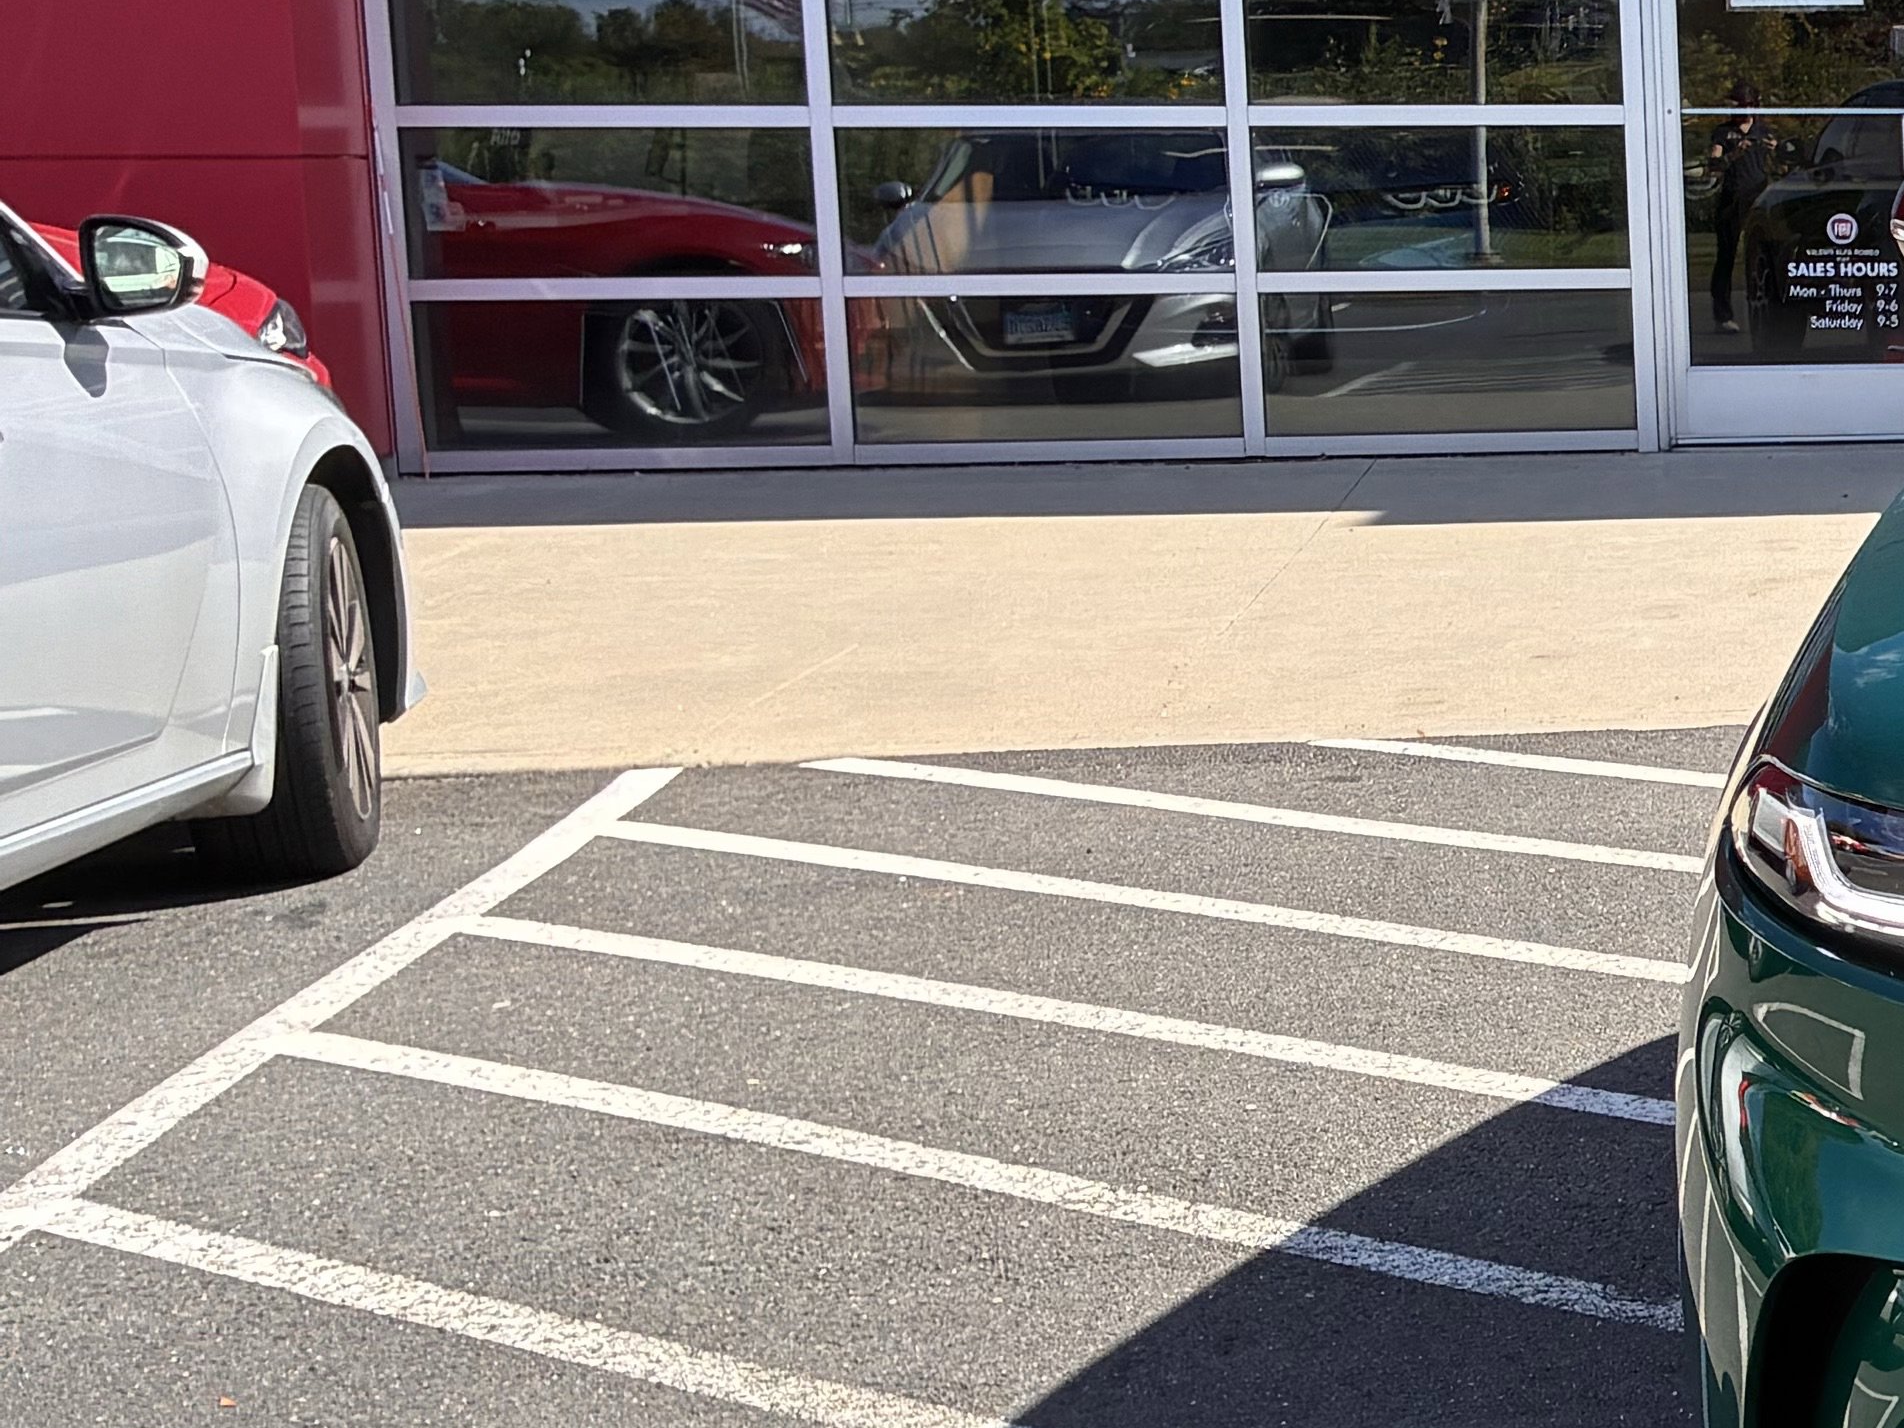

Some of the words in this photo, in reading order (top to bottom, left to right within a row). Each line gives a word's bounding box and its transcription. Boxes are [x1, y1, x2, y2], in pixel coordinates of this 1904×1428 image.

[1787, 262, 1835, 277] SALES
[1840, 262, 1899, 277] HOURS
[1789, 285, 1817, 297] Mon
[1828, 284, 1862, 297] Thurs
[1825, 299, 1863, 315] Friday
[1810, 315, 1863, 330] Saturday
